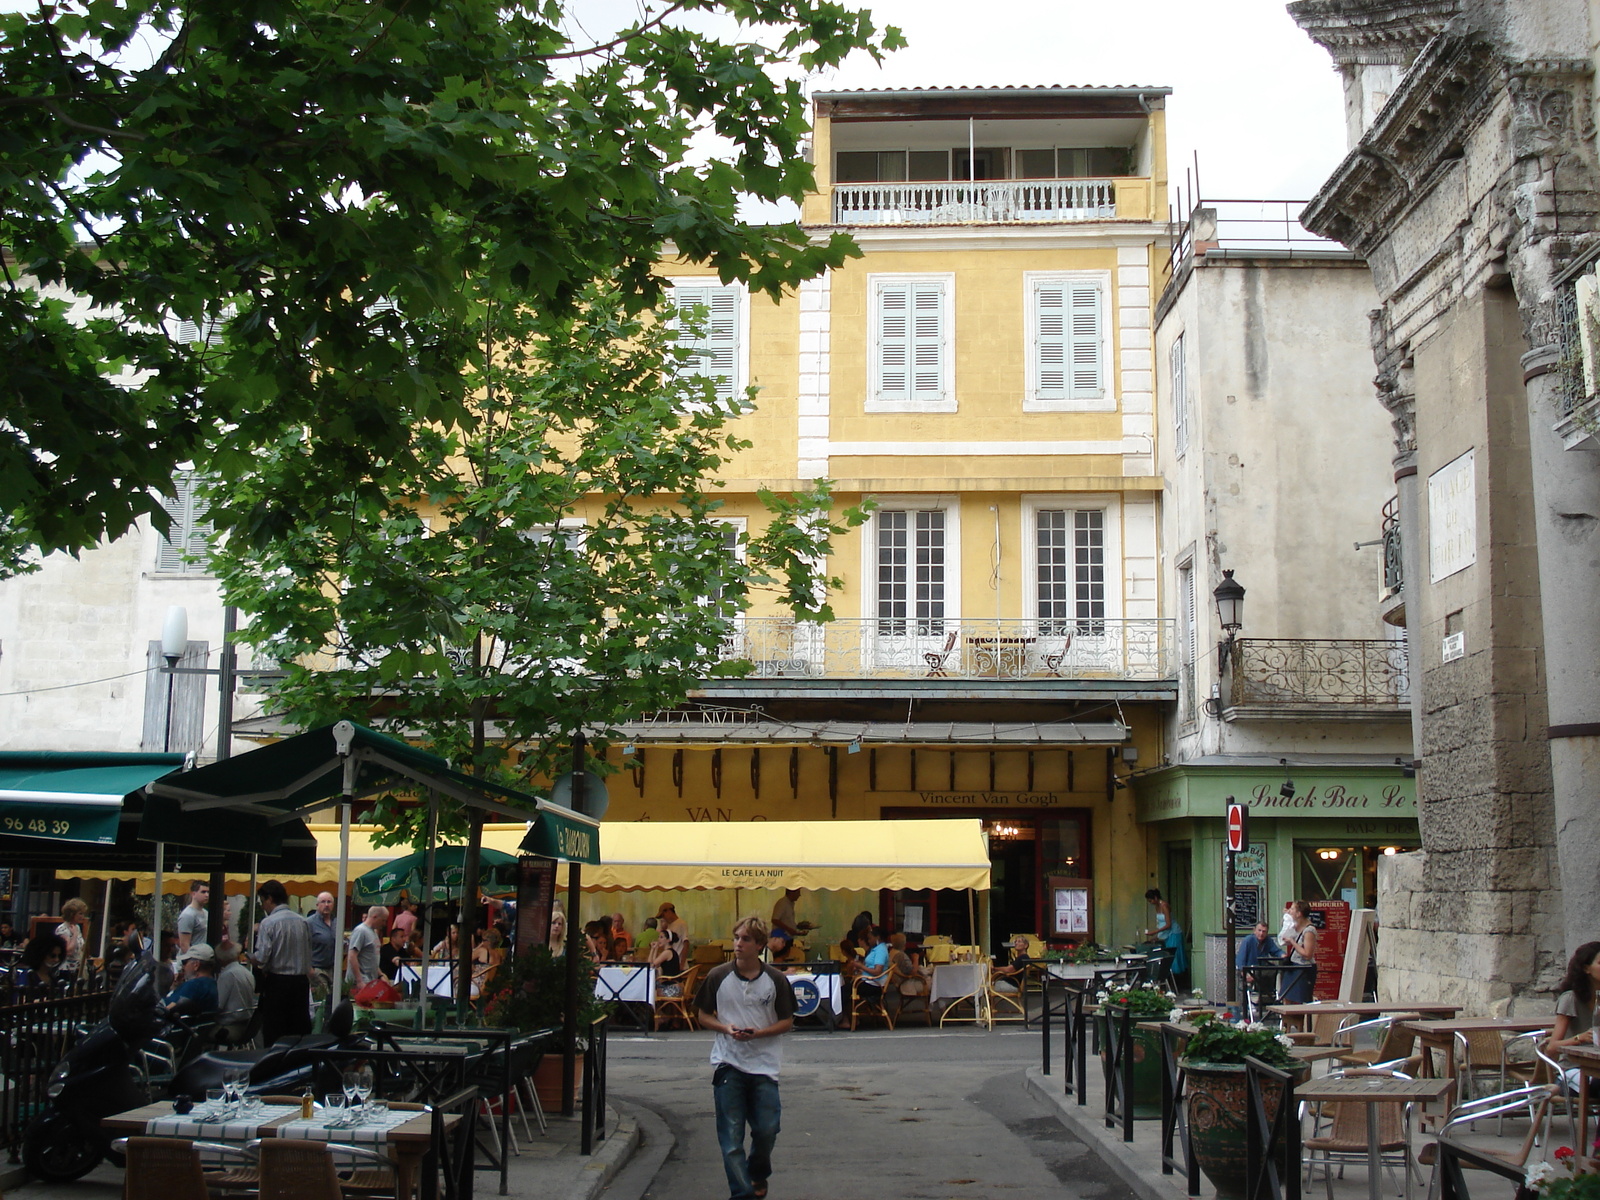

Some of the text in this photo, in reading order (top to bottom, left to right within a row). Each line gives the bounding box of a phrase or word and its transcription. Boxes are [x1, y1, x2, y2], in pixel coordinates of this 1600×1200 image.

[919, 791, 1059, 807] Vincent Van Gogh
[1247, 784, 1407, 808] Snack Bar Le
[4, 817, 70, 835] 96 48 39
[1346, 822, 1377, 834] BAR
[1250, 847, 1265, 860] BAR
[721, 869, 784, 877] LE CAFE LA NUIT
[1235, 867, 1265, 878] BOURIN
